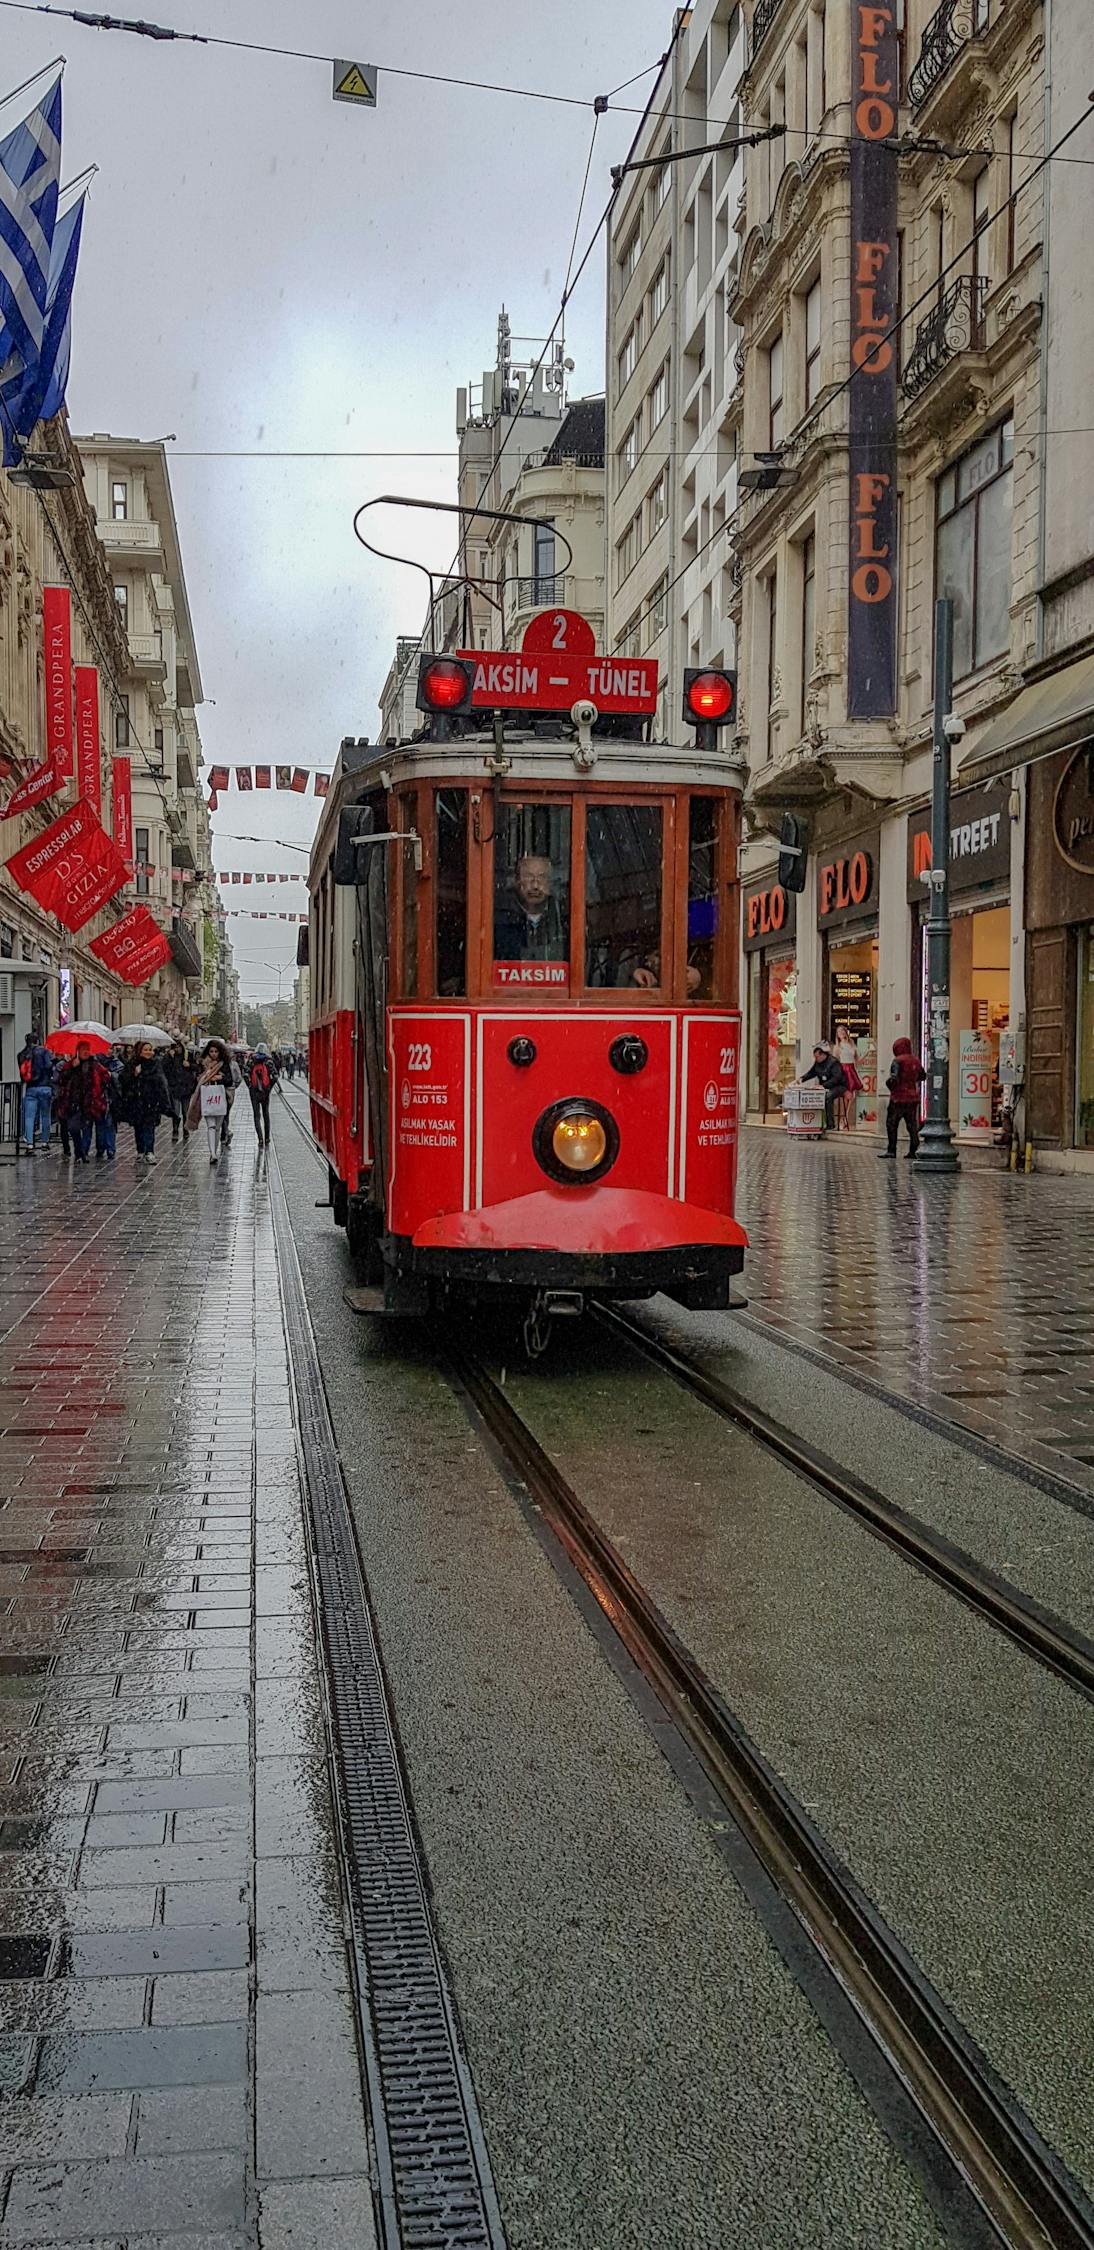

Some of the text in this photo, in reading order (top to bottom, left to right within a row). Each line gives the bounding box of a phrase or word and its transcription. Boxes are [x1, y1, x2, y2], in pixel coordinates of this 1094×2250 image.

[856, 6, 894, 140] FLO
[852, 241, 893, 374] FLO
[852, 472, 893, 603] FLO
[552, 614, 567, 650] 2
[51, 623, 66, 738] GRANDPERA
[473, 658, 538, 695] AKSİM
[587, 661, 652, 698] TÜNEL
[83, 698, 95, 795] GRANDPERA
[25, 818, 84, 874] ESPRESSOLAB
[950, 812, 1001, 861] TREET
[66, 863, 109, 905] GIZIA
[820, 851, 868, 915] FLO
[747, 884, 785, 938] FLO
[498, 965, 565, 982] TAKSİM
[408, 1043, 432, 1071] 223
[412, 1095, 429, 1104] ALO
[430, 1095, 448, 1104] 153
[966, 1072, 989, 1094] 30
[406, 1133, 458, 1147] TEHLİKELİDİR
[428, 1119, 456, 1131] YASAK
[697, 1134, 708, 1146] VE
